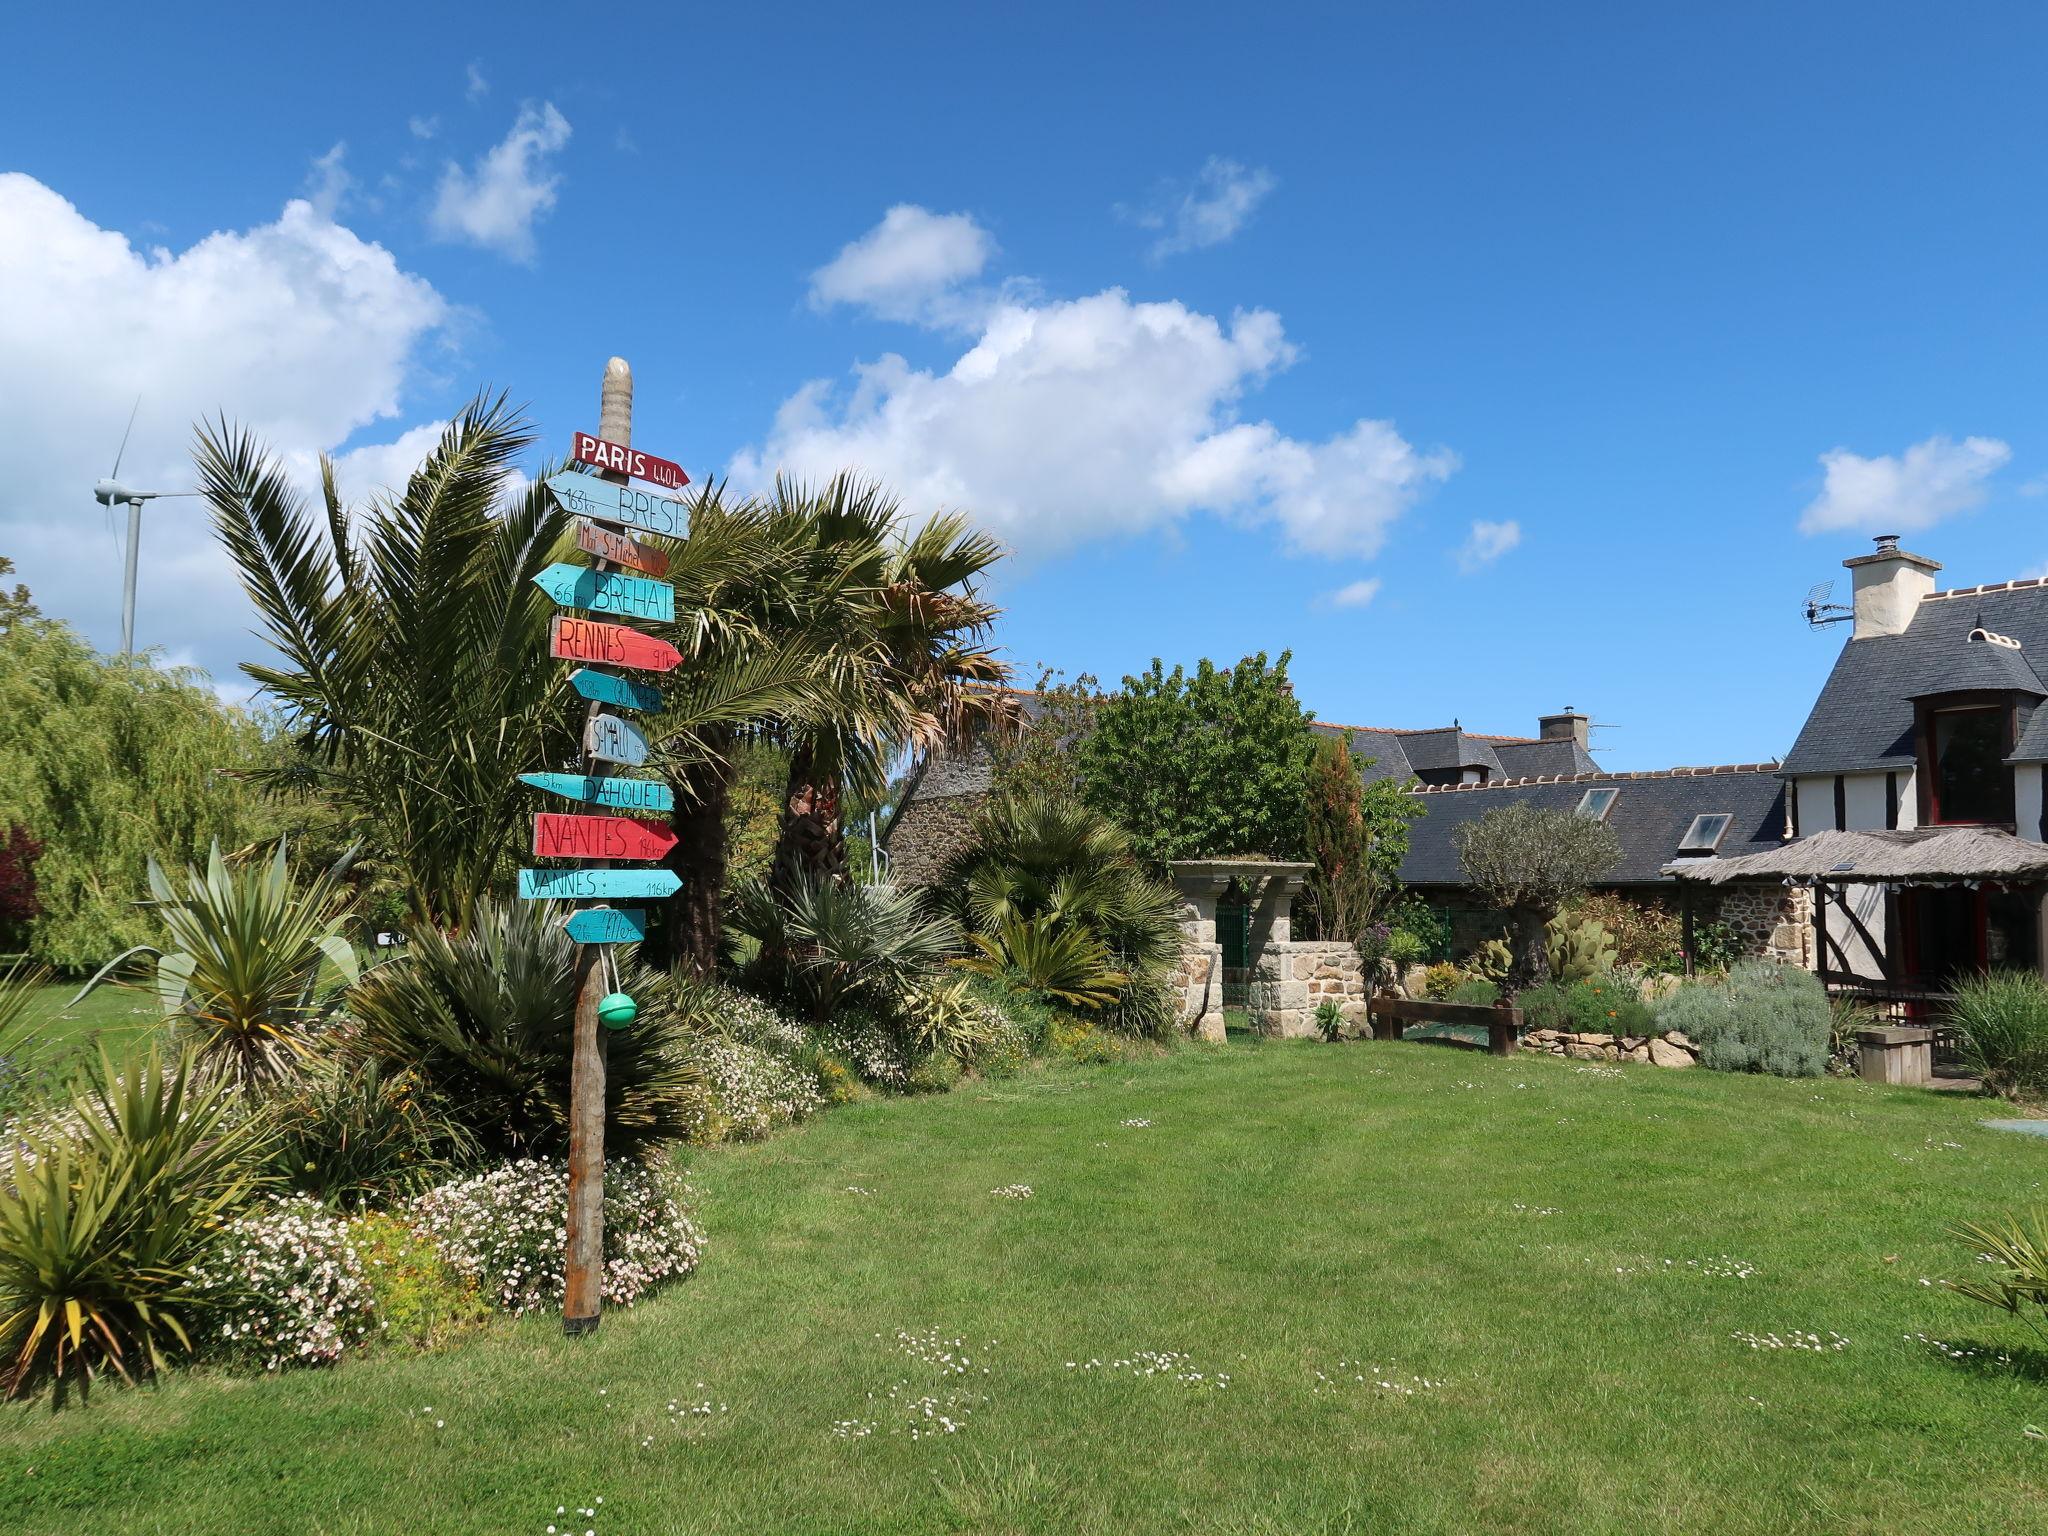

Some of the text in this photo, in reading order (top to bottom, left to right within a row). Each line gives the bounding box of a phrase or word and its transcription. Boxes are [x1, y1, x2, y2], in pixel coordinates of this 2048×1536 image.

[581, 436, 646, 476] PARIS
[619, 487, 683, 535] BREST
[594, 572, 671, 620] BREHAT
[559, 619, 626, 663] RENNES
[541, 816, 627, 857] NANTES
[524, 871, 597, 896] VANNES
